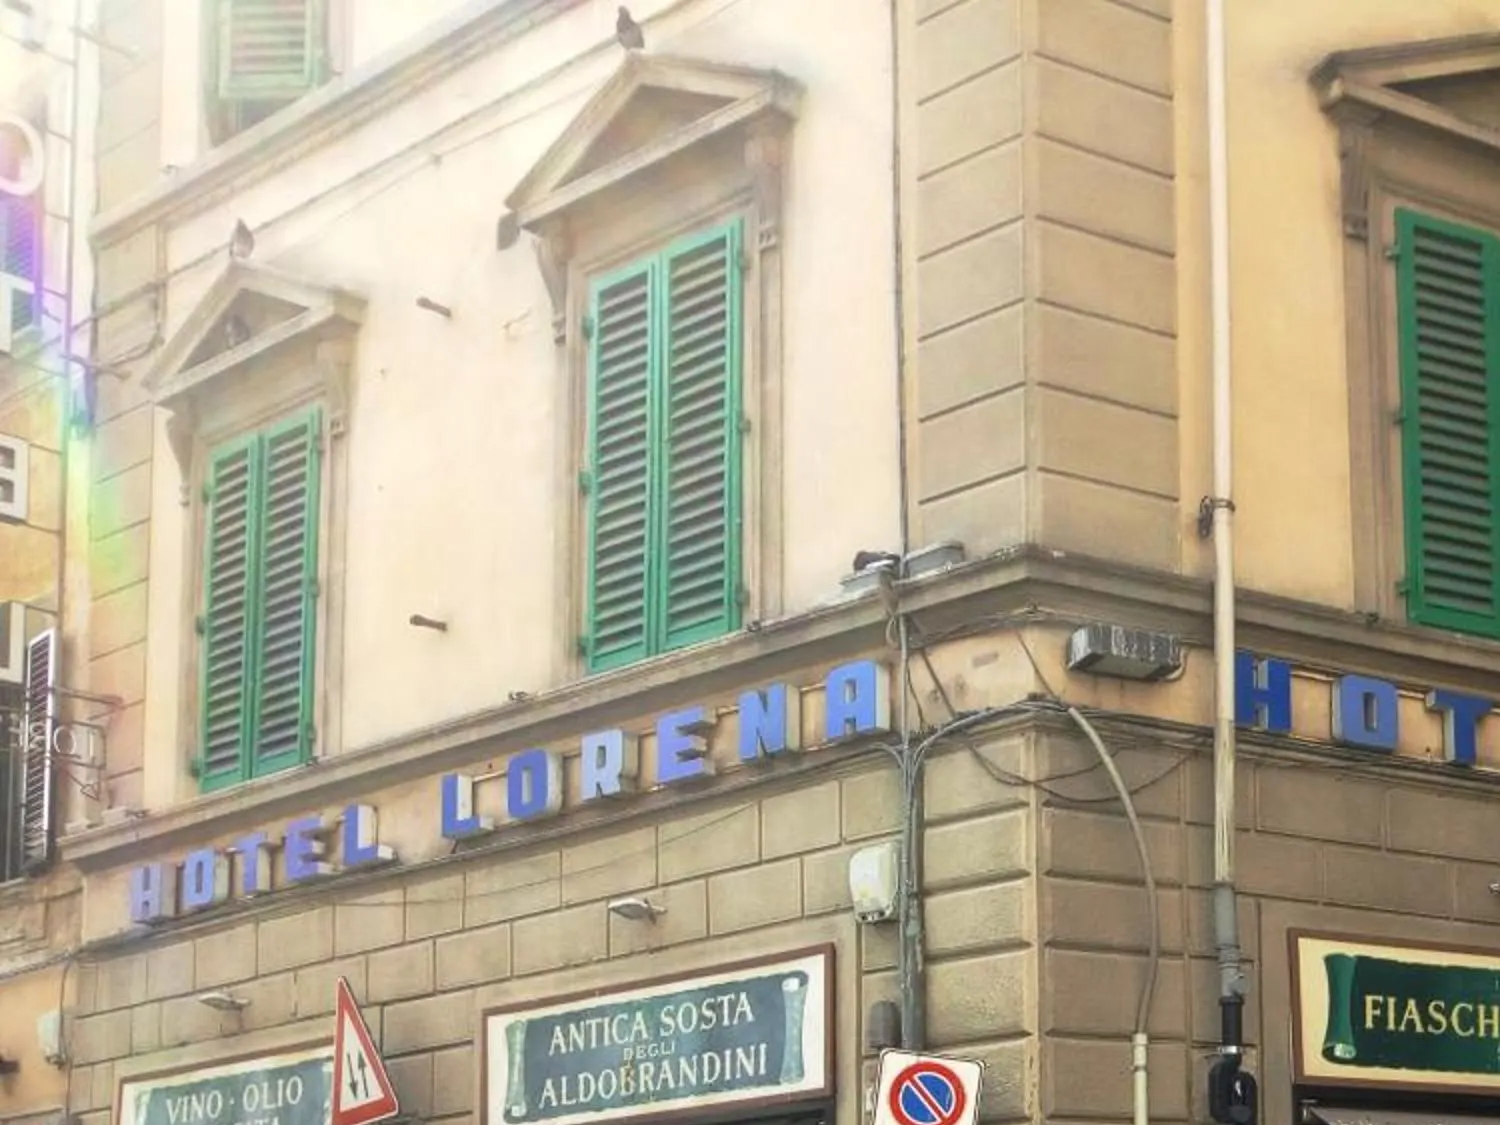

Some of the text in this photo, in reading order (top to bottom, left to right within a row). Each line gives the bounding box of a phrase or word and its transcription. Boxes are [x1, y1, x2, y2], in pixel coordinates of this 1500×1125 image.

[131, 658, 889, 924] HOTEL LORENA
[549, 991, 755, 1058] ANTICA SOSTA
[623, 1040, 676, 1061] DEGLI
[242, 1075, 303, 1115] OLIO
[538, 1043, 768, 1109] ALDOBRANDINI
